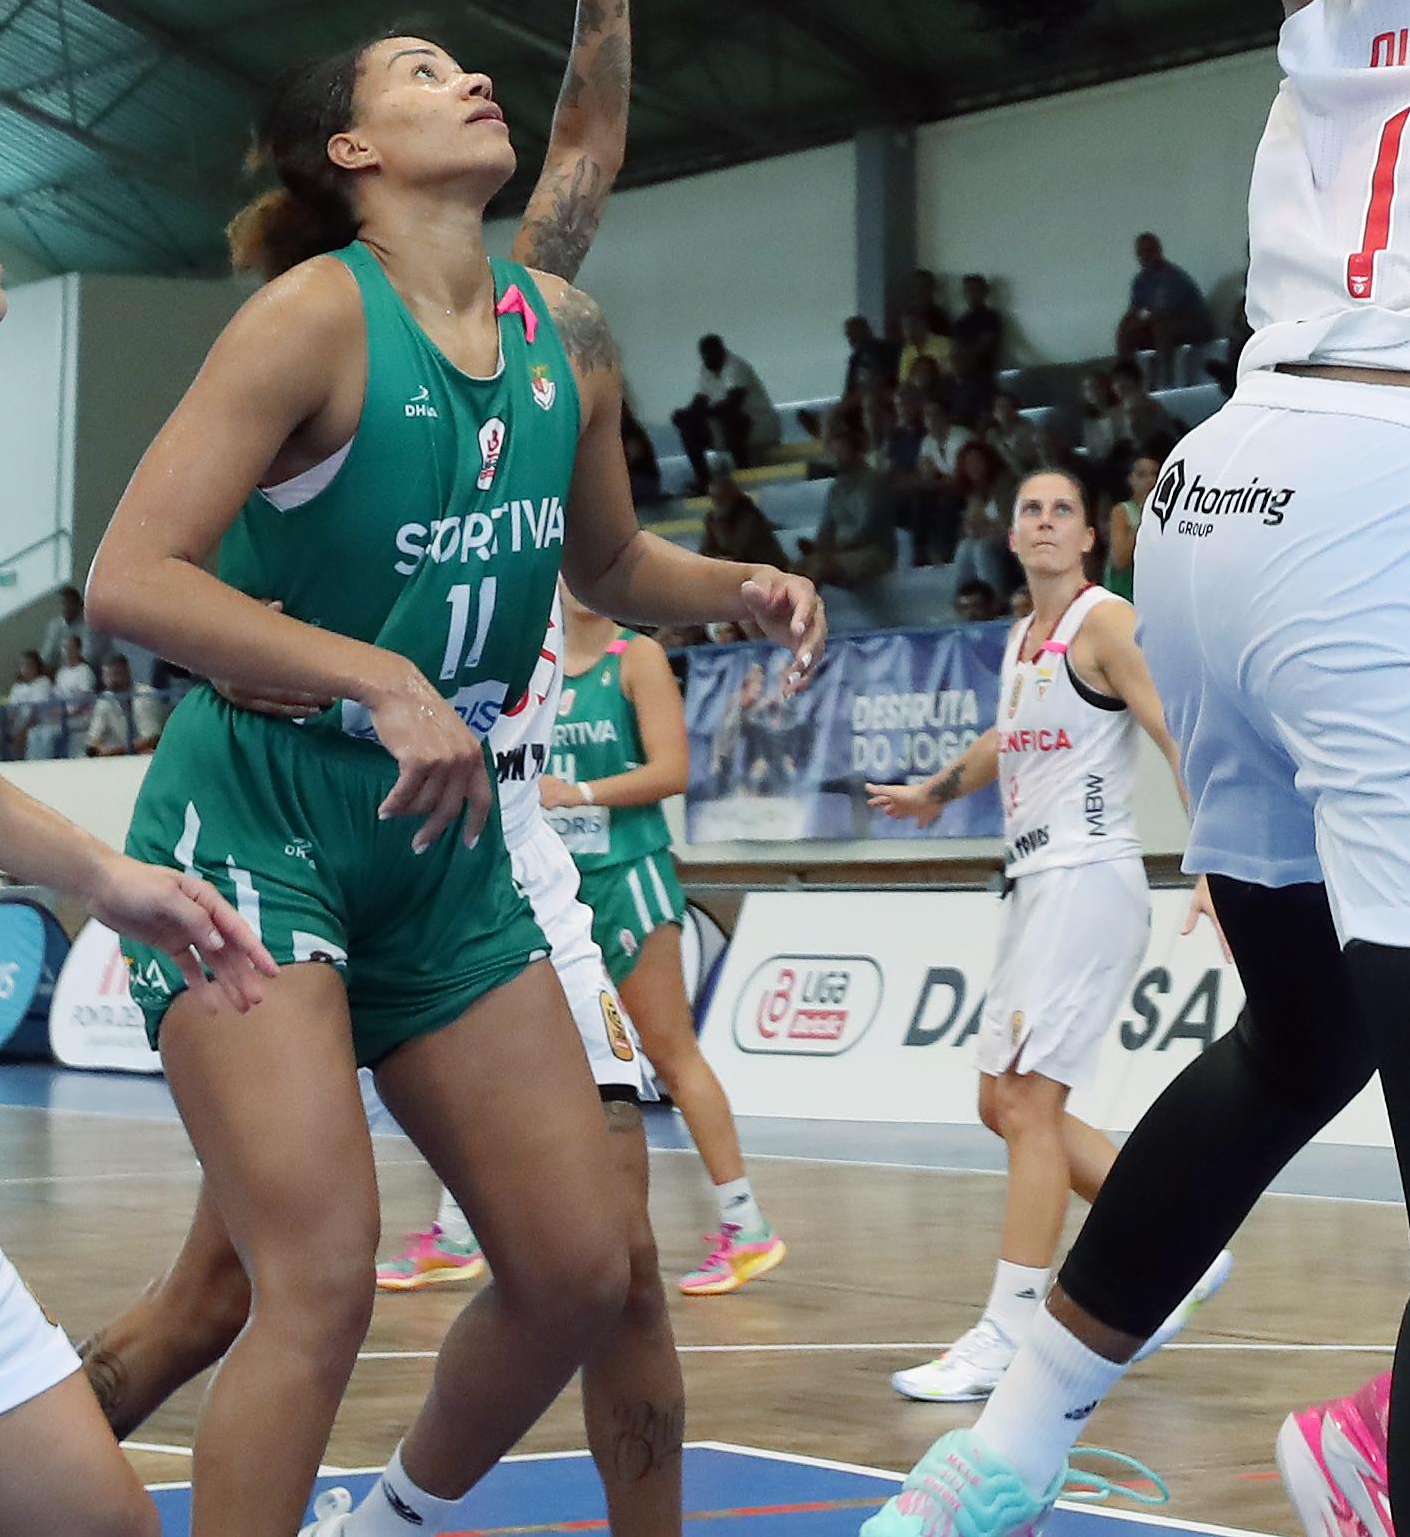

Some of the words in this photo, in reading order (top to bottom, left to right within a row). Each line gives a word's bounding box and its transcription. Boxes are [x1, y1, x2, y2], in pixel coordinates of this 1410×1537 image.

[1178, 520, 1215, 538] GROUP
[1183, 474, 1296, 527] homing
[393, 496, 566, 576] SORTIVA
[439, 576, 497, 681] 11
[852, 733, 892, 772] DO
[1083, 773, 1107, 838] MBW
